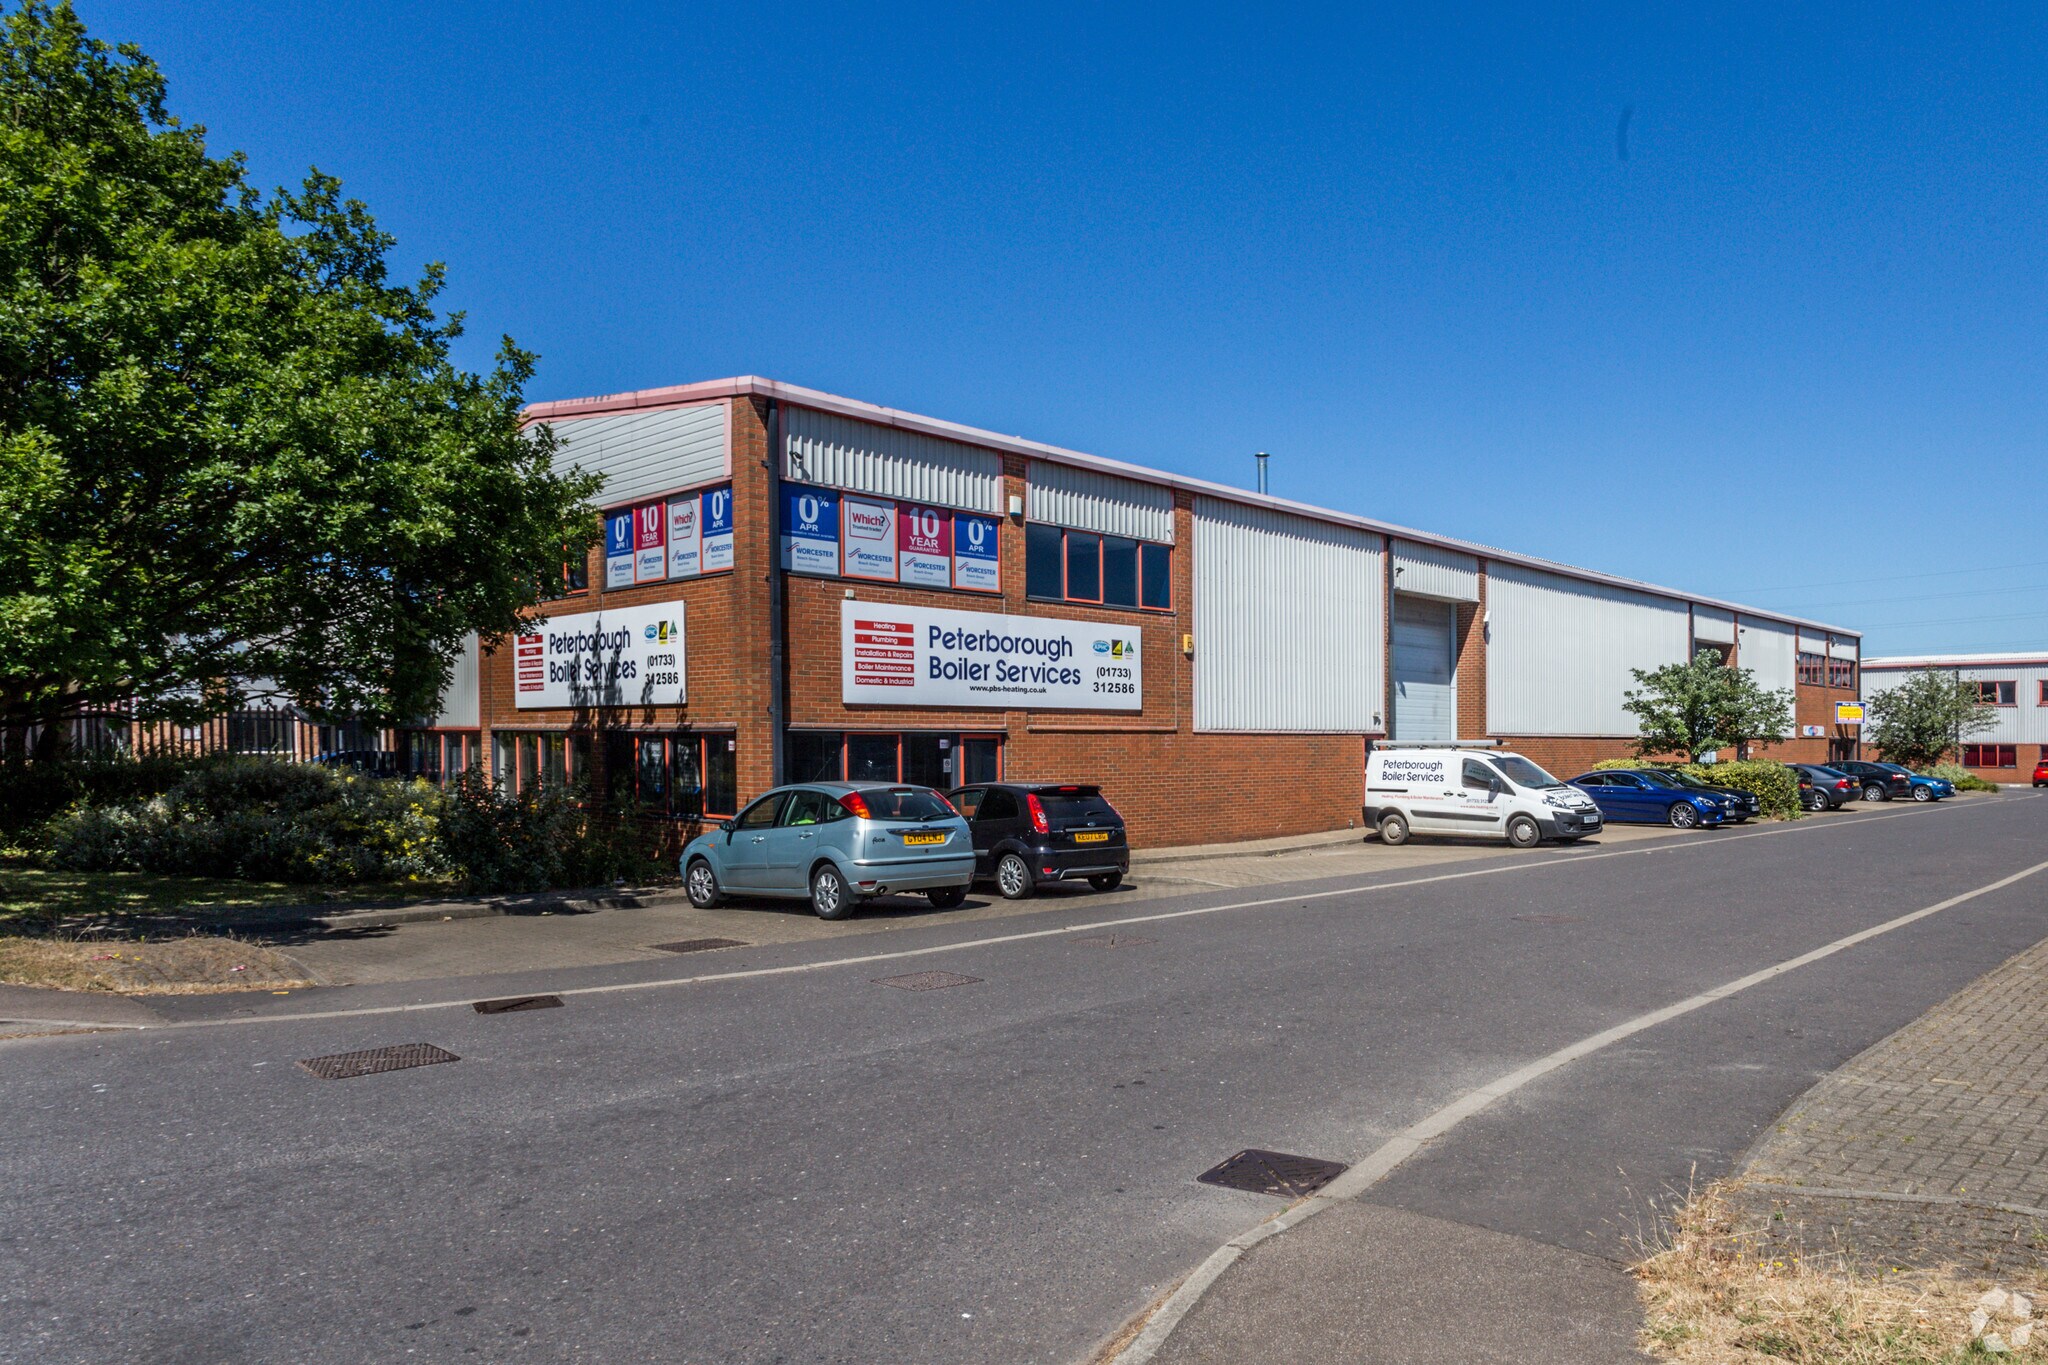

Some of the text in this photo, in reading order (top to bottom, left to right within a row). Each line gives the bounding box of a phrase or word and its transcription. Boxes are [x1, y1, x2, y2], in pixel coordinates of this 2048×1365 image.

[641, 505, 659, 533] 10
[712, 520, 724, 528] APR
[852, 512, 886, 527] Which?
[909, 507, 940, 539] 10
[799, 523, 819, 532] APR
[641, 532, 658, 543] YEAR
[909, 536, 939, 548] YEAR
[616, 541, 626, 549] APR
[968, 545, 984, 553] APR
[796, 547, 834, 558] WORCESTER
[857, 553, 893, 563] WORCESTER
[913, 562, 946, 571] WORCESTER
[966, 566, 996, 576] WORCESTER
[873, 622, 896, 631] Heating
[549, 625, 631, 656] Peterborough
[871, 635, 899, 645] Plumbing
[928, 625, 1073, 662] Peterborough
[856, 649, 887, 657] Installation
[892, 651, 913, 659] Repairs
[647, 653, 676, 669] (01733)
[549, 656, 637, 683] Boiler Services
[874, 663, 912, 672] Maintenance
[929, 655, 1082, 685] Boiler Services
[1096, 666, 1132, 680] (01733)
[645, 672, 679, 685] 312586
[856, 676, 883, 684] Domestic
[969, 685, 1047, 695] www.pbs-heating.co.uk
[1093, 681, 1135, 694] 312586
[1383, 759, 1443, 772] Peterborough
[1382, 771, 1445, 782] Boiler Services
